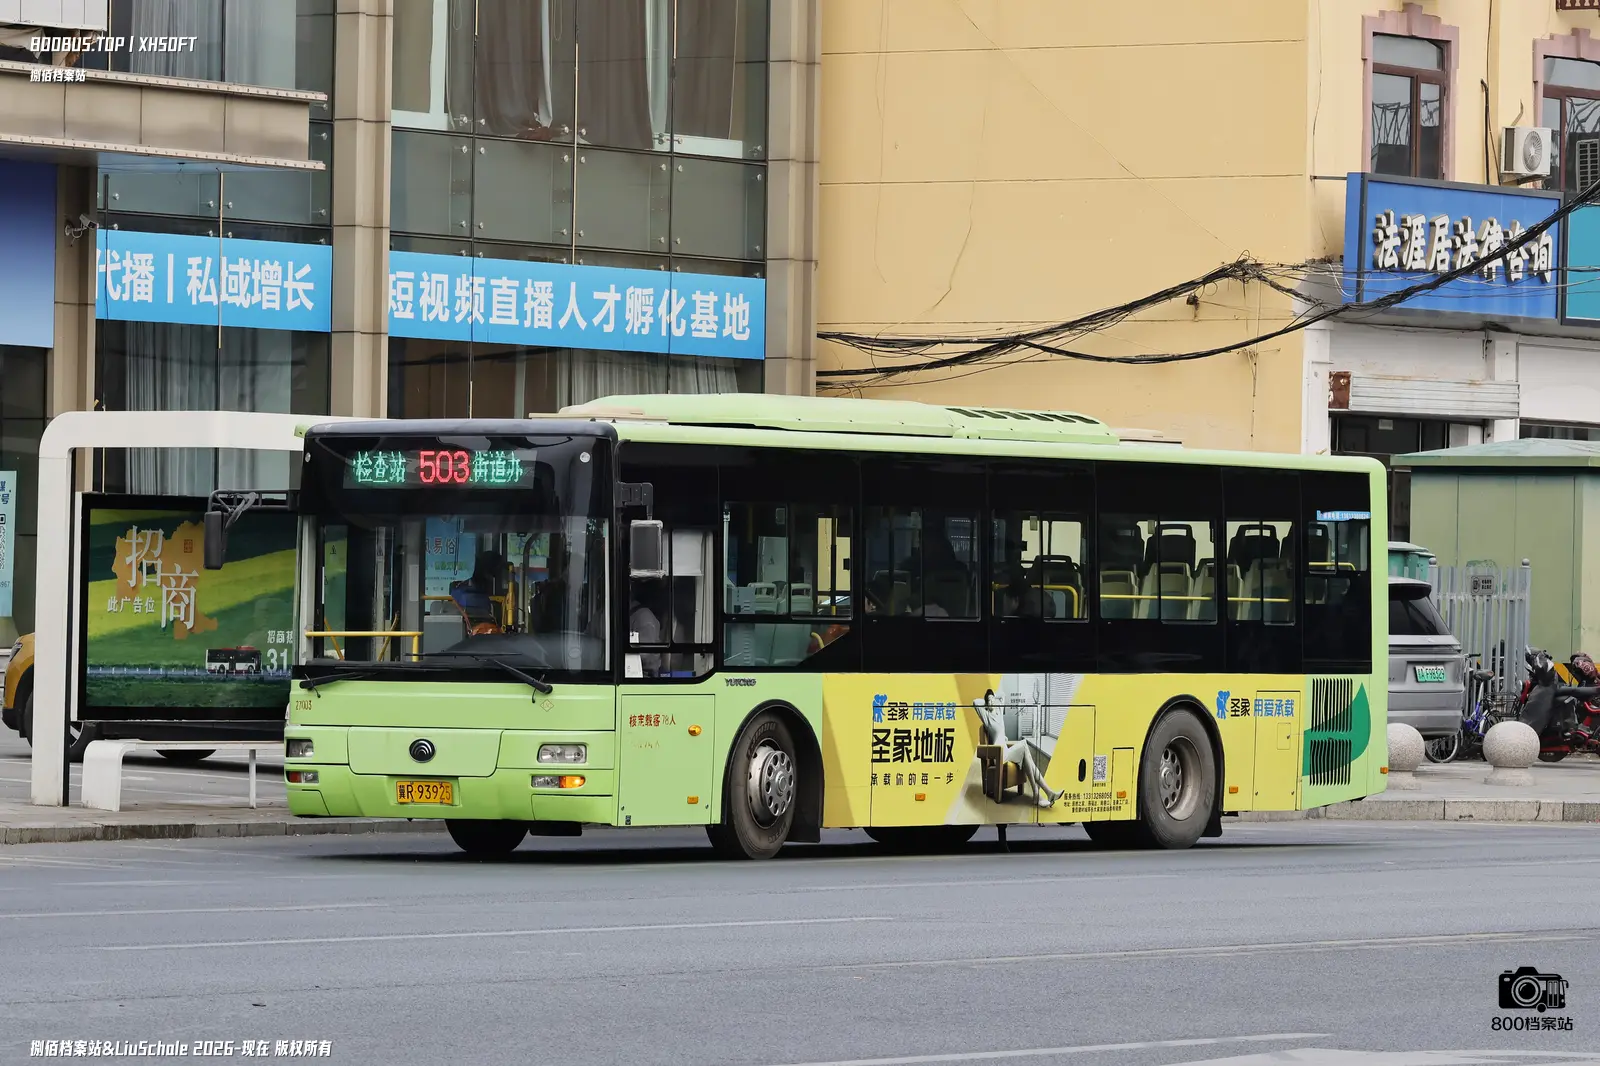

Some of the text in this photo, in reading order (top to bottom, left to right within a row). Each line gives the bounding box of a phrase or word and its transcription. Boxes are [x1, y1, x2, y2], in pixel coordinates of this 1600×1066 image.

[388, 269, 751, 342] 短视频直播人才孵化基地
[419, 450, 470, 483] 503
[107, 596, 155, 614] 此广告位
[725, 678, 757, 687] YUTONG
[295, 700, 312, 711] 27003
[887, 702, 956, 721] 圣象 用爱承载
[1230, 698, 1295, 717] 圣象 用爱承载
[871, 727, 955, 763] 圣象地板
[871, 772, 954, 786] 承载你的每一步
